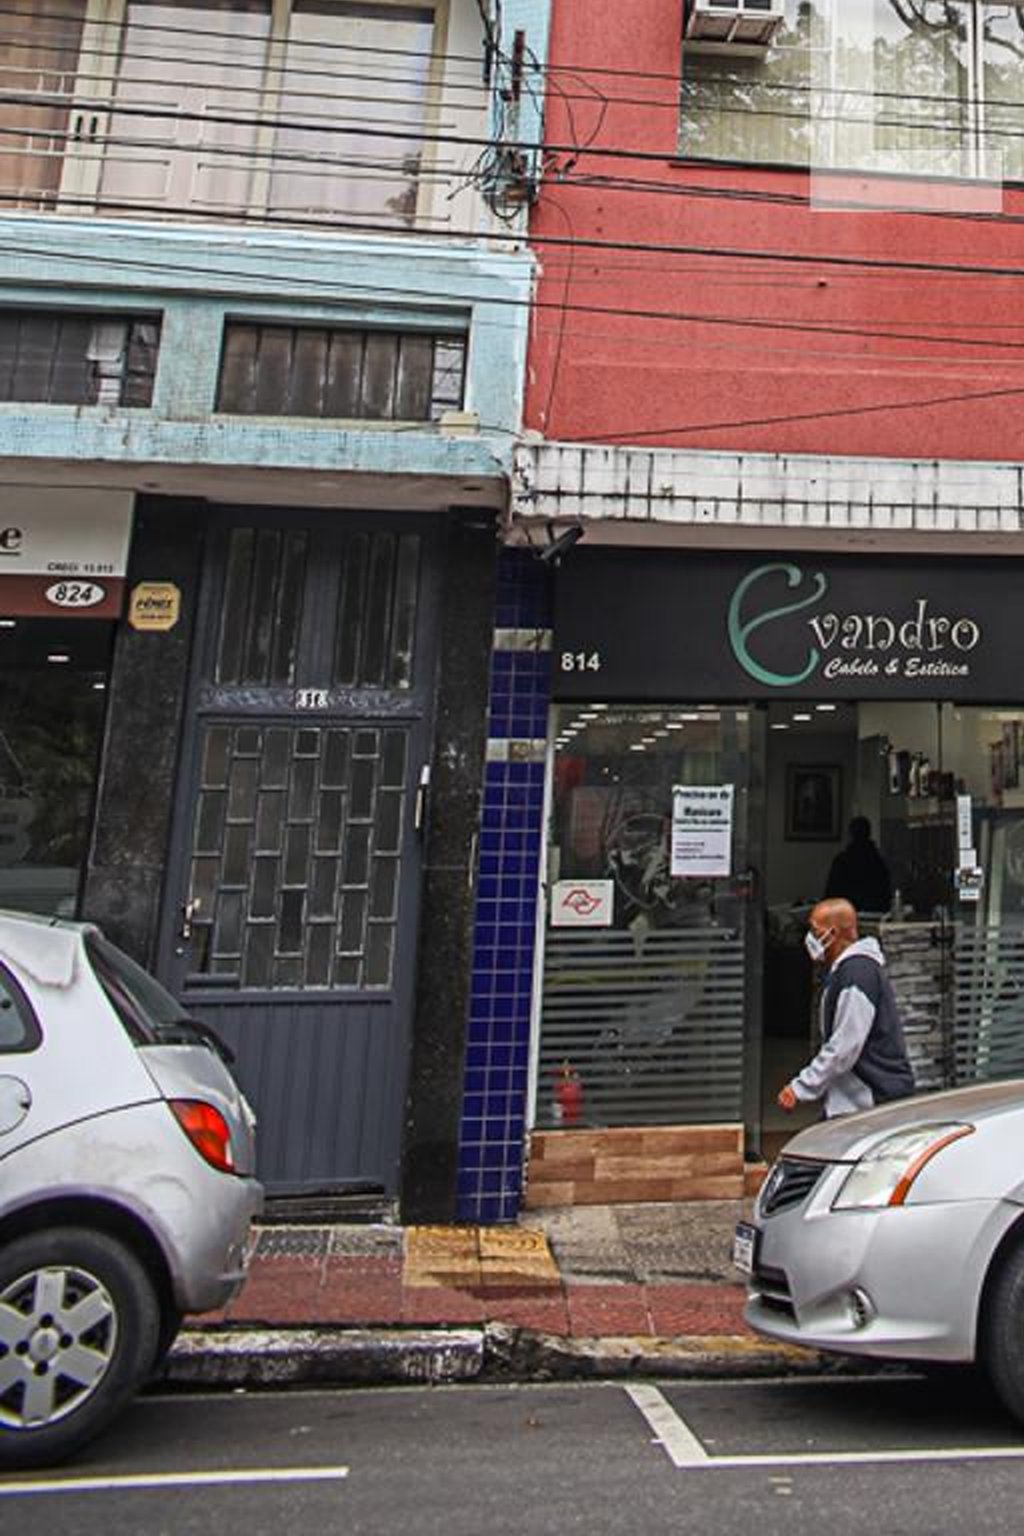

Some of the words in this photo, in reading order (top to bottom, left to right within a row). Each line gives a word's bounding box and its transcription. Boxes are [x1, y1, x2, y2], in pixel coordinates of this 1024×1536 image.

[55, 584, 93, 602] 824
[728, 563, 980, 686] Evandro
[561, 652, 601, 671] 814
[823, 657, 880, 678] Cabelo
[884, 658, 899, 674] &
